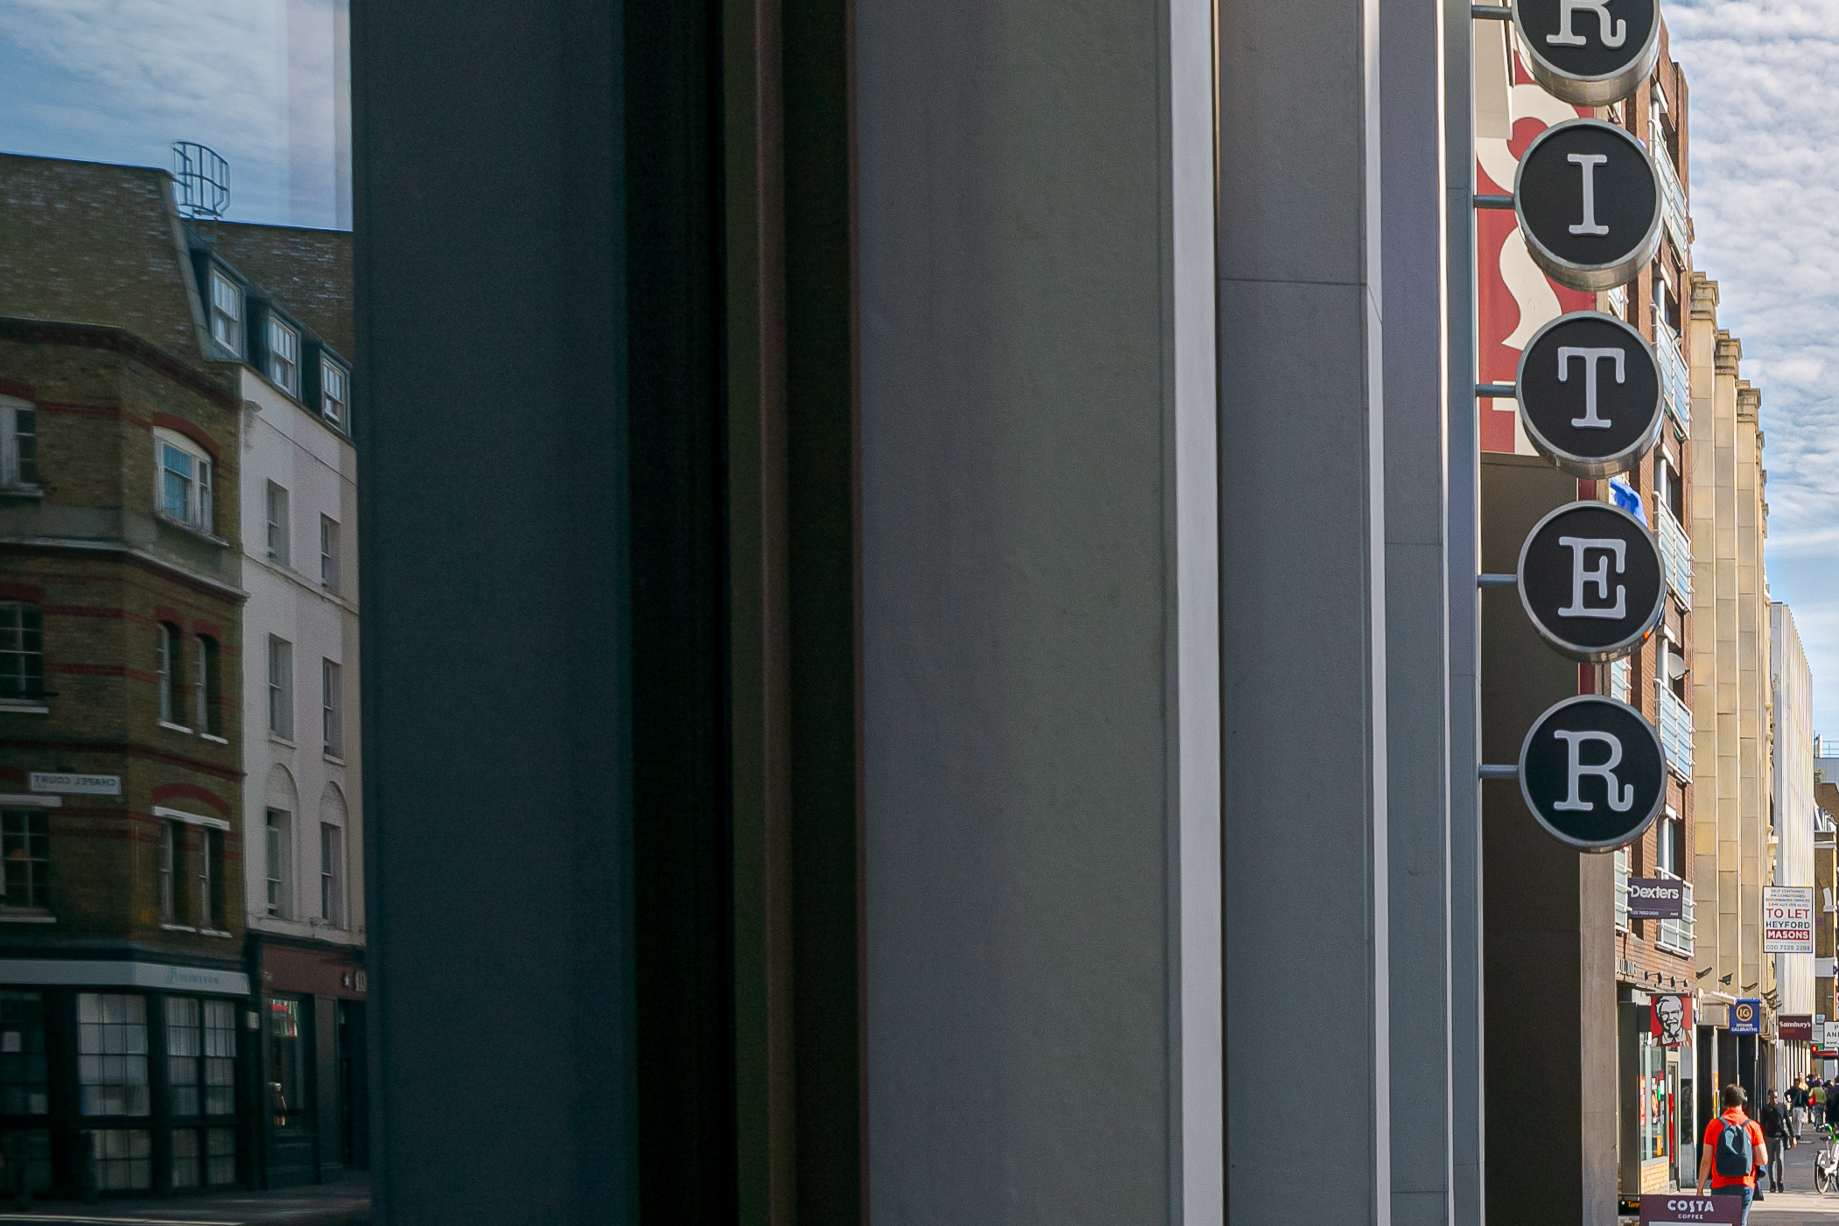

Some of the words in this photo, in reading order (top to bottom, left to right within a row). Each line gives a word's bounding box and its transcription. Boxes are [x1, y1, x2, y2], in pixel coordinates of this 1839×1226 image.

[1630, 884, 1680, 900] Dexters
[1766, 908, 1784, 919] TO
[1787, 908, 1810, 919] LET
[1765, 921, 1811, 929] HEYFORD
[1767, 930, 1809, 939] MASONS
[1667, 1199, 1714, 1213] COSTA
